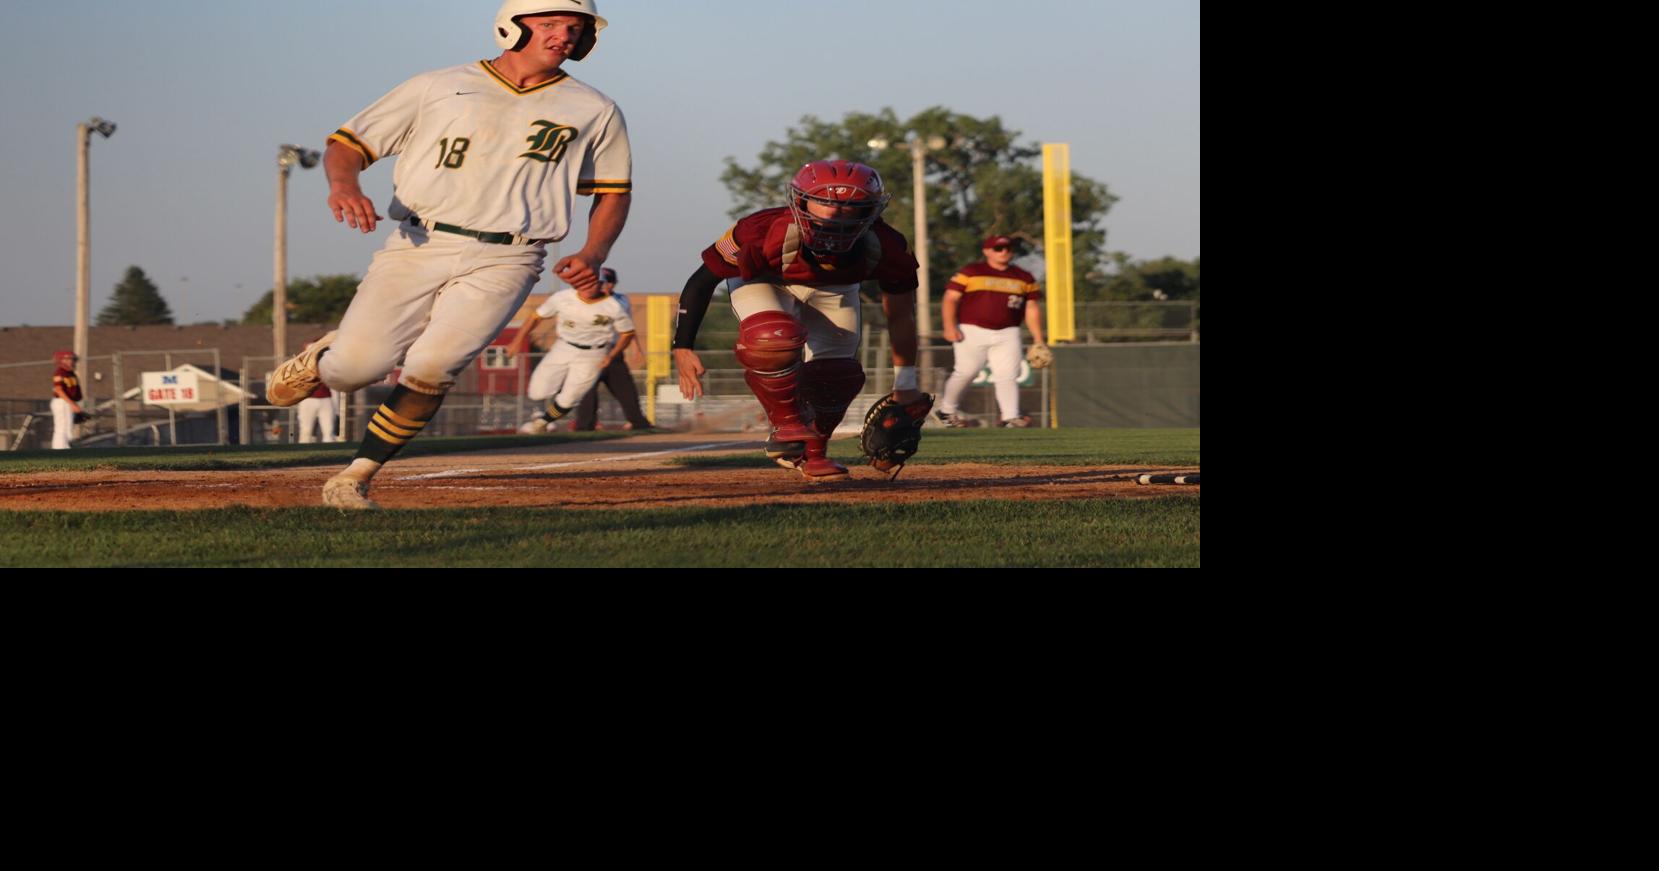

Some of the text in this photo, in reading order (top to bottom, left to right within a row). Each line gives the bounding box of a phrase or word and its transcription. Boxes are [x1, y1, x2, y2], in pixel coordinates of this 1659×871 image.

[435, 137, 470, 169] 18
[517, 119, 579, 163] B
[148, 388, 193, 400] GATE 18
